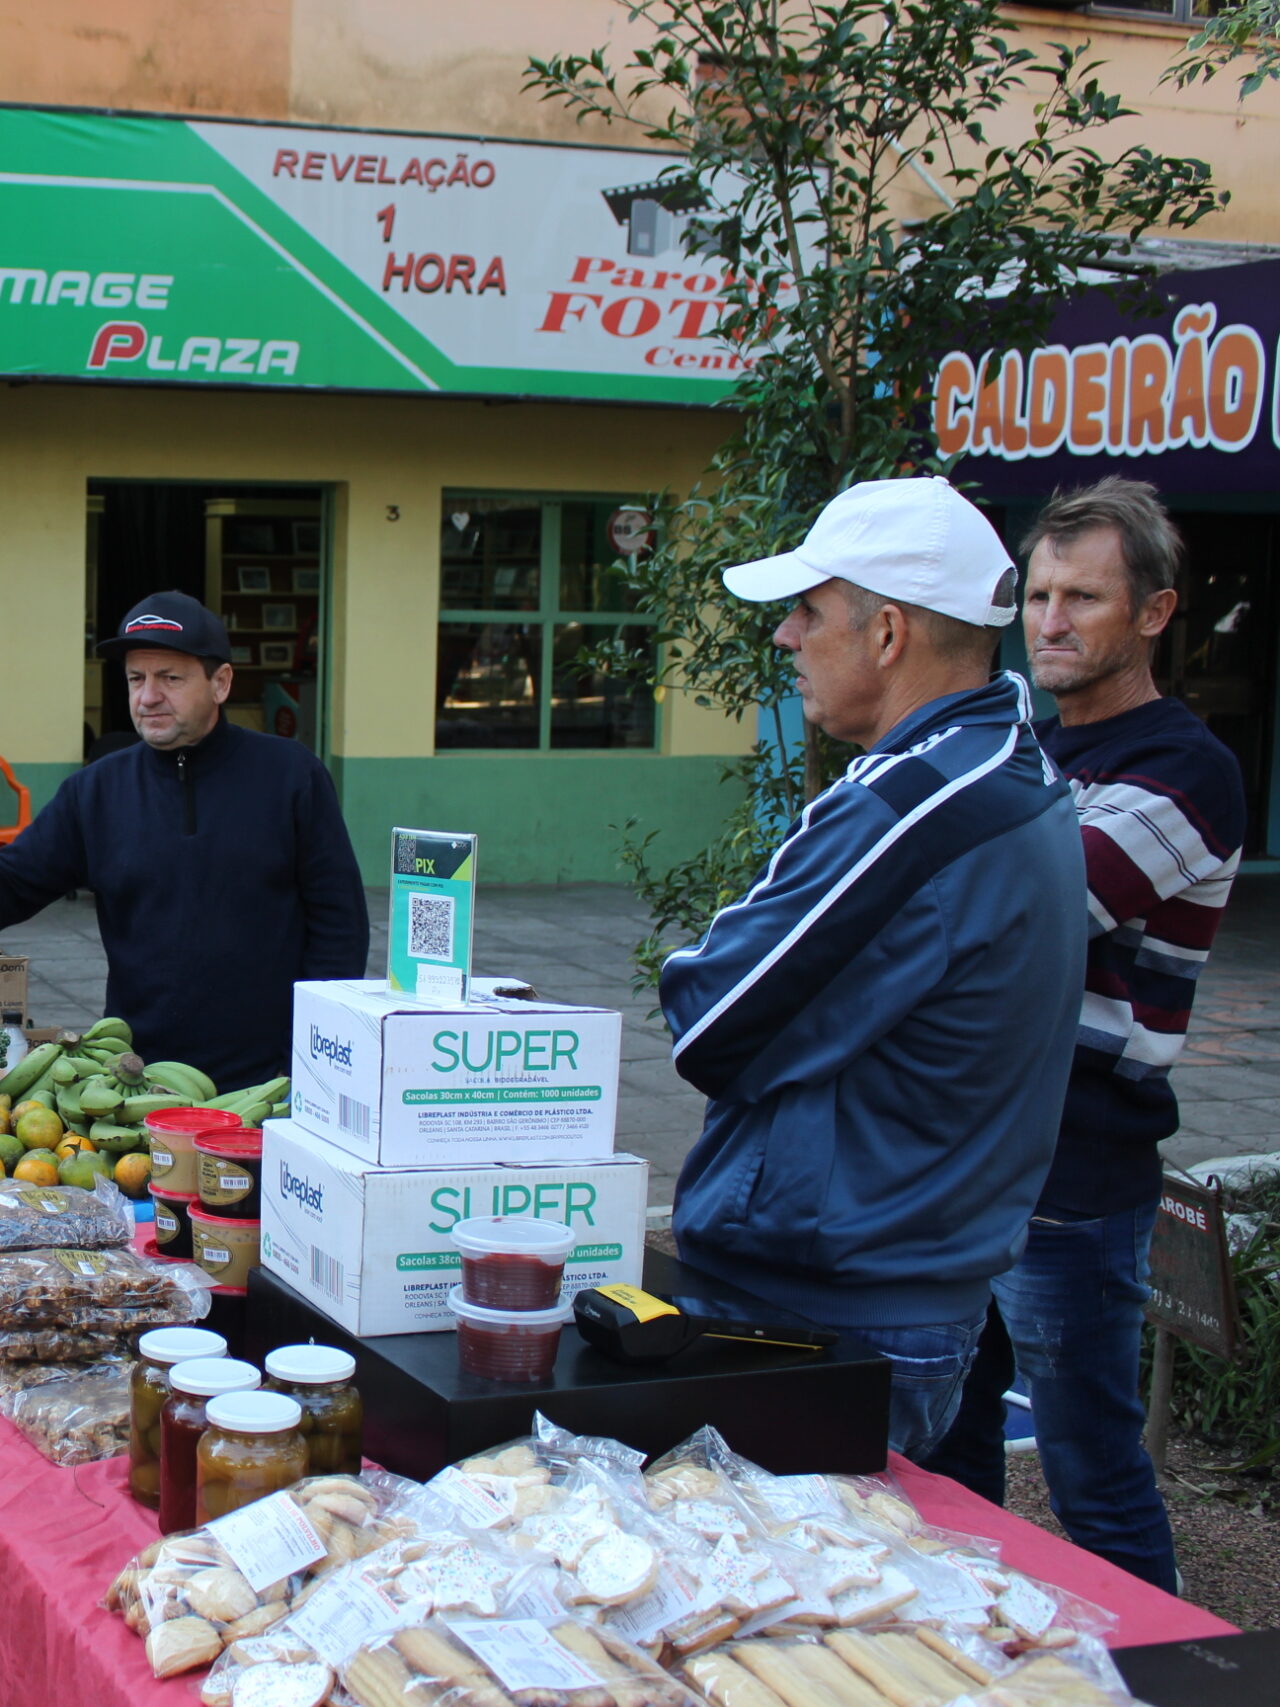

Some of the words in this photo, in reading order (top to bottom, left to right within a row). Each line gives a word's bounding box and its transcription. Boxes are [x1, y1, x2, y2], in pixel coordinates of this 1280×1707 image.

[272, 149, 496, 193] REVELAÇÃO
[376, 203, 397, 244] 1
[382, 251, 507, 297] HORA
[86, 320, 300, 375] PLAZA
[932, 302, 1266, 462] CALDEIRÃO
[386, 505, 400, 522] 3
[415, 858, 435, 874] PIX
[431, 1030, 579, 1073] SUPER
[405, 1091, 438, 1101] Sacolas
[440, 1091, 463, 1100] 30cm
[464, 1092, 470, 1100] x
[472, 1090, 495, 1099] 40cm
[503, 1088, 538, 1099] Contém:
[541, 1088, 559, 1098] 1000
[561, 1087, 599, 1098] unidades
[457, 1109, 492, 1117] INDÚSTRIA
[499, 1108, 533, 1116] COMÉRCIO
[545, 1107, 574, 1116] PLÁSTICO
[428, 1182, 597, 1234] SUPER
[1159, 1196, 1206, 1230] AROBÉ
[400, 1256, 437, 1267] Sacolas
[577, 1245, 619, 1257] unidades
[403, 1282, 448, 1291] LIBREPLAST
